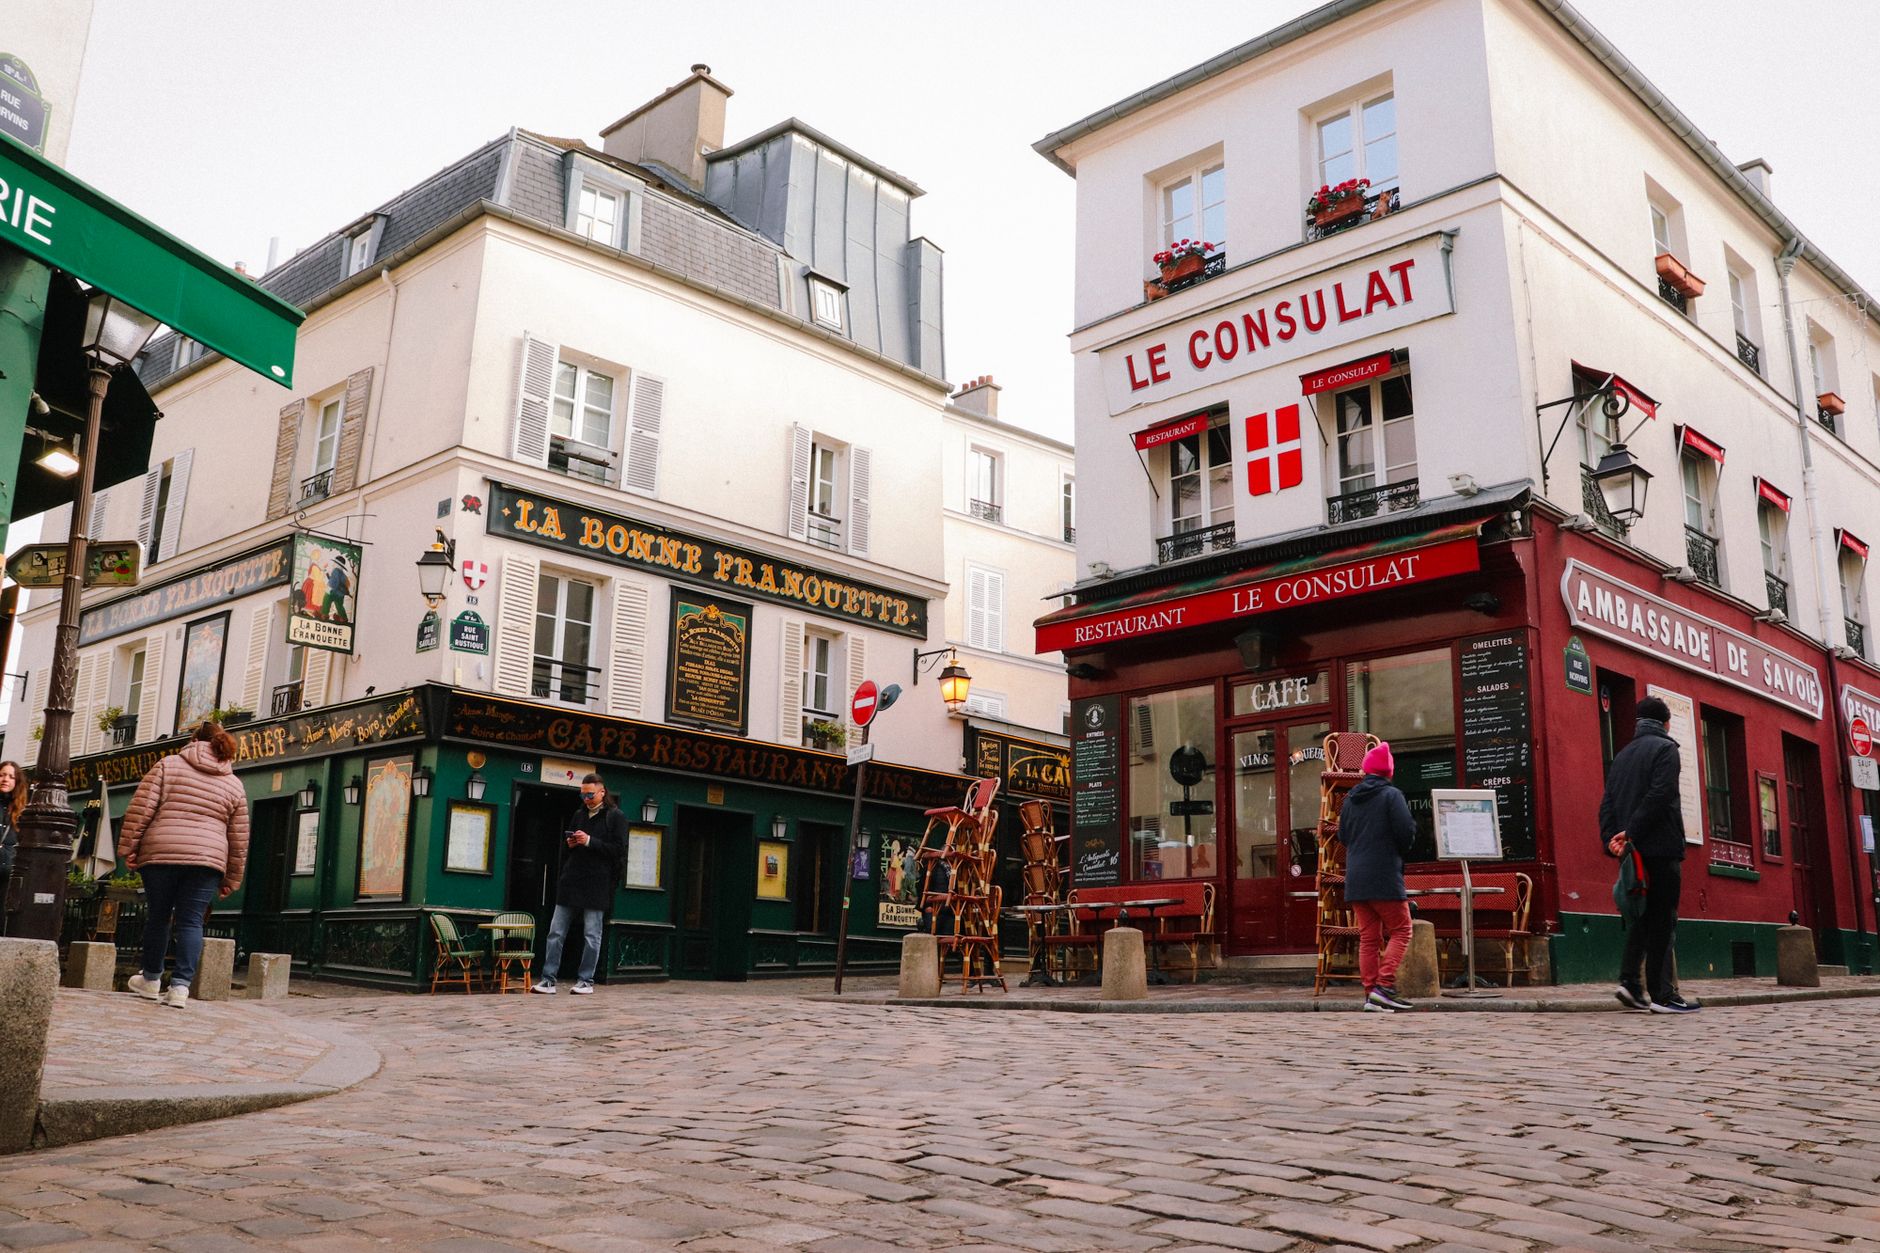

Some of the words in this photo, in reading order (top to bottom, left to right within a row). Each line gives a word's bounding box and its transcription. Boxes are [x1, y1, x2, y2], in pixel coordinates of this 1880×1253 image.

[1, 89, 21, 109] RUE
[0, 106, 28, 130] RVINS
[1124, 342, 1171, 391] LE
[1188, 258, 1416, 370] CONSULAT
[1312, 378, 1324, 389] LE
[1327, 362, 1379, 385] CONSULAT
[1146, 421, 1197, 444] RESTAURANT
[514, 499, 567, 540] LA
[579, 516, 702, 574] BONNE
[713, 551, 909, 626] FRANQUETTE
[84, 608, 106, 636] LA
[110, 594, 161, 630] BONNE
[164, 549, 284, 613] FRANQUETTE
[1075, 607, 1186, 643] RESTAURANT
[1232, 590, 1264, 613] LE
[1274, 555, 1421, 604] CONSULAT
[300, 620, 311, 630] LA
[315, 623, 343, 636] BONNE
[424, 625, 434, 633] RUE
[464, 626, 476, 634] RUE
[293, 628, 349, 647] FRANQUETTE
[419, 638, 437, 647] SAULES
[455, 639, 484, 650] RUSTIQUE
[461, 632, 479, 641] SAINT
[1472, 637, 1513, 650] OMELETTES
[1577, 580, 1711, 662] AMBASSADE
[1727, 640, 1750, 677] DE
[1762, 657, 1819, 707] SAVOIE
[1573, 660, 1583, 670] RUE
[1477, 682, 1510, 693] SALADES
[1086, 730, 1105, 739] ENTRÉES
[232, 727, 286, 763] ARET
[651, 732, 849, 790] RESTAURANT
[1240, 753, 1269, 768] VINS
[1290, 747, 1326, 766] LQUEUR
[523, 763, 531, 771] 18
[1026, 763, 1039, 779] LA
[1088, 781, 1103, 789] PLATS
[1483, 776, 1511, 786] CRÊPES
[886, 904, 893, 913] LA
[896, 905, 915, 915] BONNE
